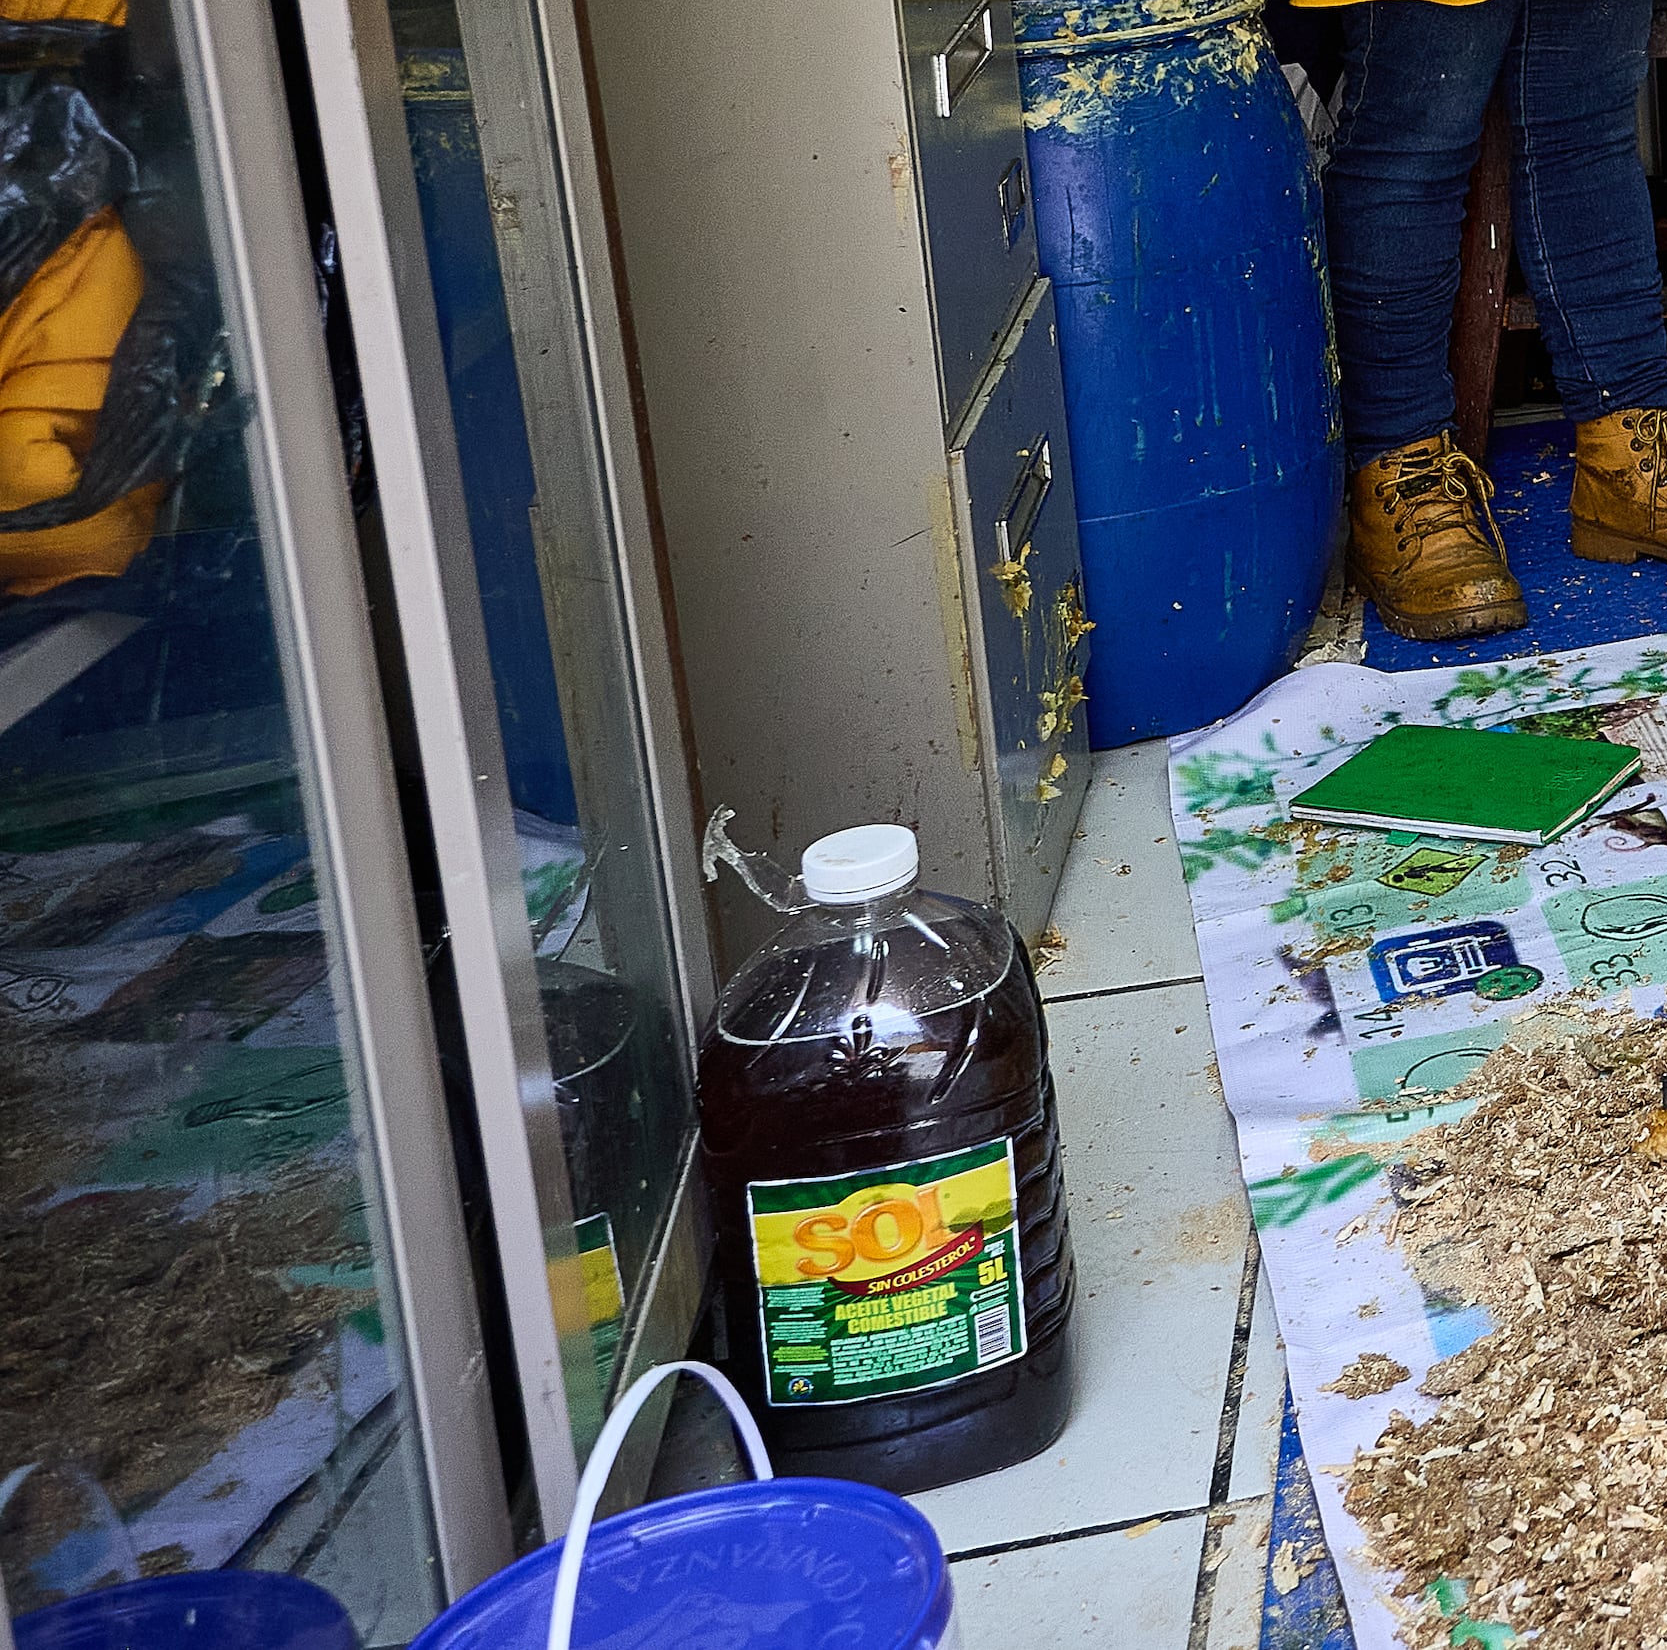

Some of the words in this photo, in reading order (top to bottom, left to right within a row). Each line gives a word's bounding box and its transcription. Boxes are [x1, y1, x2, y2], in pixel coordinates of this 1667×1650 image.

[1539, 859, 1588, 887] 32
[1330, 903, 1376, 933] 13
[1589, 954, 1641, 991] 33
[1353, 1011, 1406, 1040] 14
[793, 1185, 954, 1277] SOL
[866, 1278, 892, 1295] SIN
[892, 1239, 972, 1289] COLESTEROL
[977, 1255, 1009, 1287] 5L
[834, 1296, 890, 1321] ACEITE
[891, 1282, 958, 1313] VEGETAL
[847, 1300, 949, 1335] COMESTIBLE
